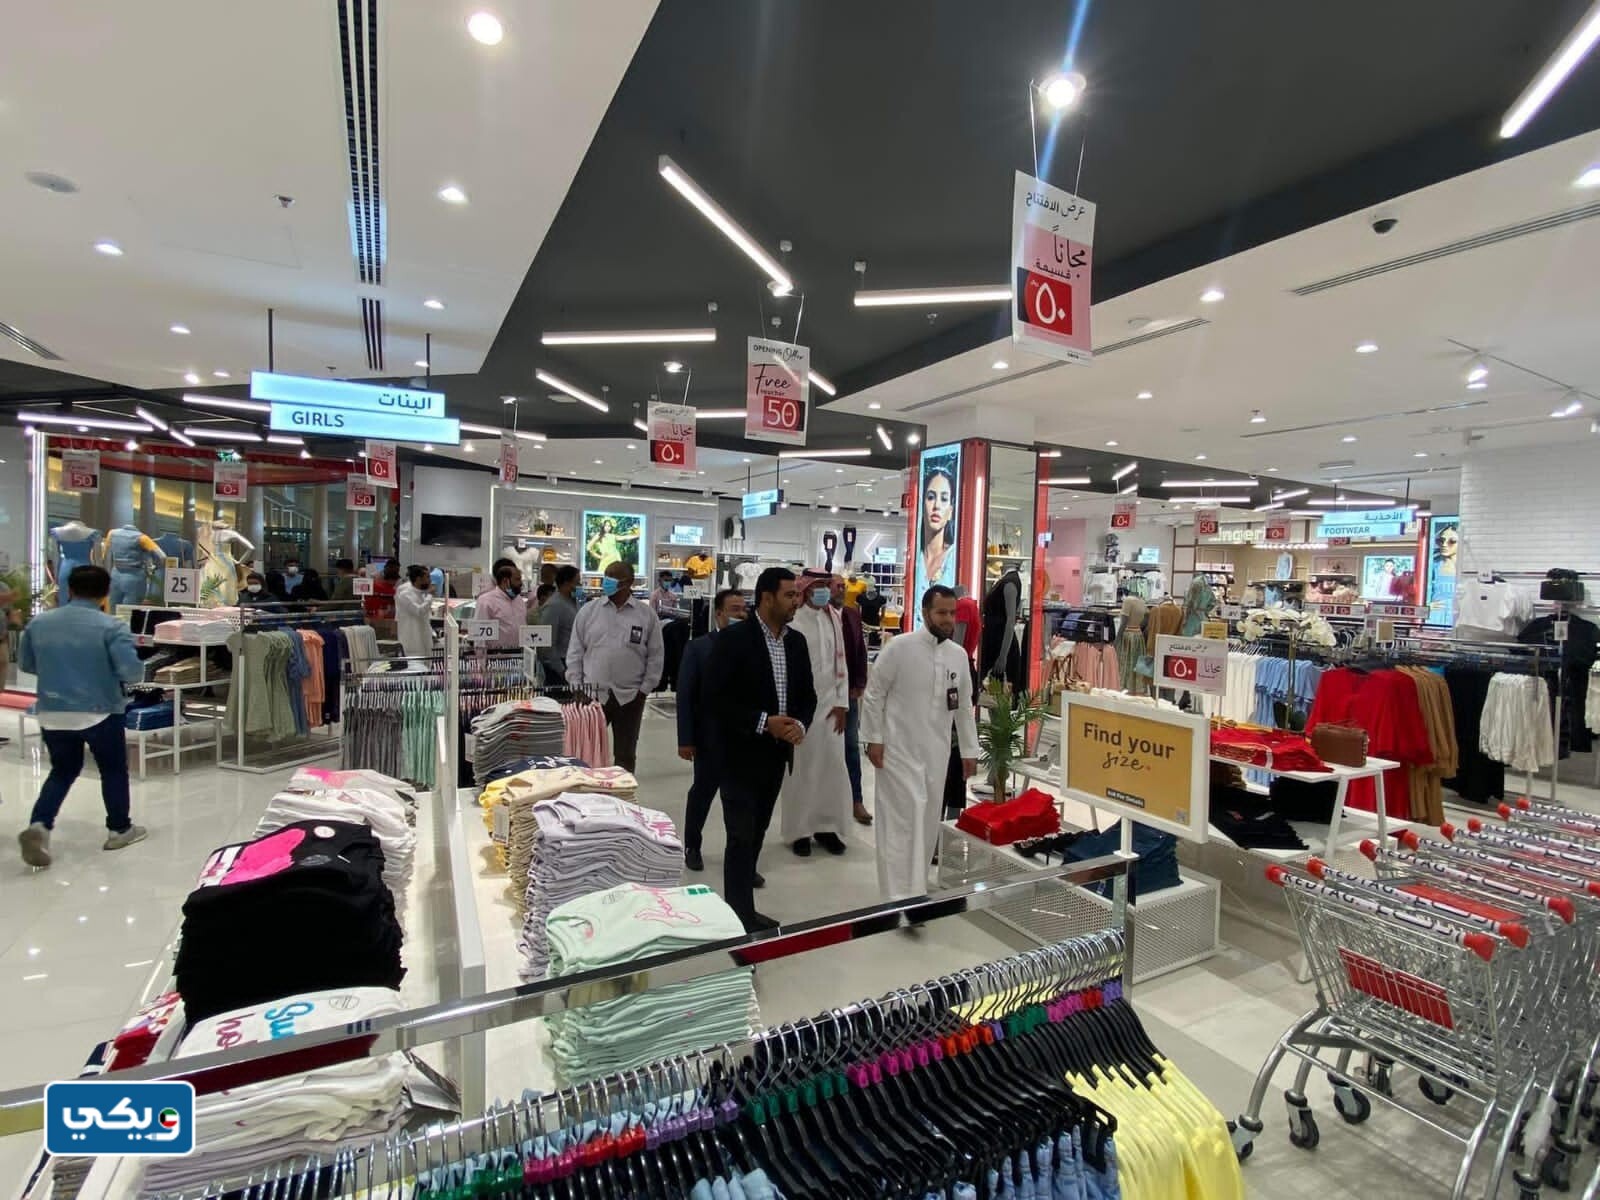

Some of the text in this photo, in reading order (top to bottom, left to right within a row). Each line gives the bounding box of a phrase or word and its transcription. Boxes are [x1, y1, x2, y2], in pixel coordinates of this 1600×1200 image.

[1035, 282, 1066, 324] ٥٠
[753, 345, 782, 355] OPENING
[753, 363, 791, 396] Free
[378, 392, 431, 414] البنات
[292, 411, 344, 428] GIRLS
[766, 399, 797, 428] 50
[661, 444, 680, 462] ٥٠
[73, 473, 93, 487] 50
[1325, 526, 1370, 535] FOOTWEAR
[171, 577, 188, 593] 25
[479, 627, 493, 637] 70
[1084, 722, 1175, 759] Find your
